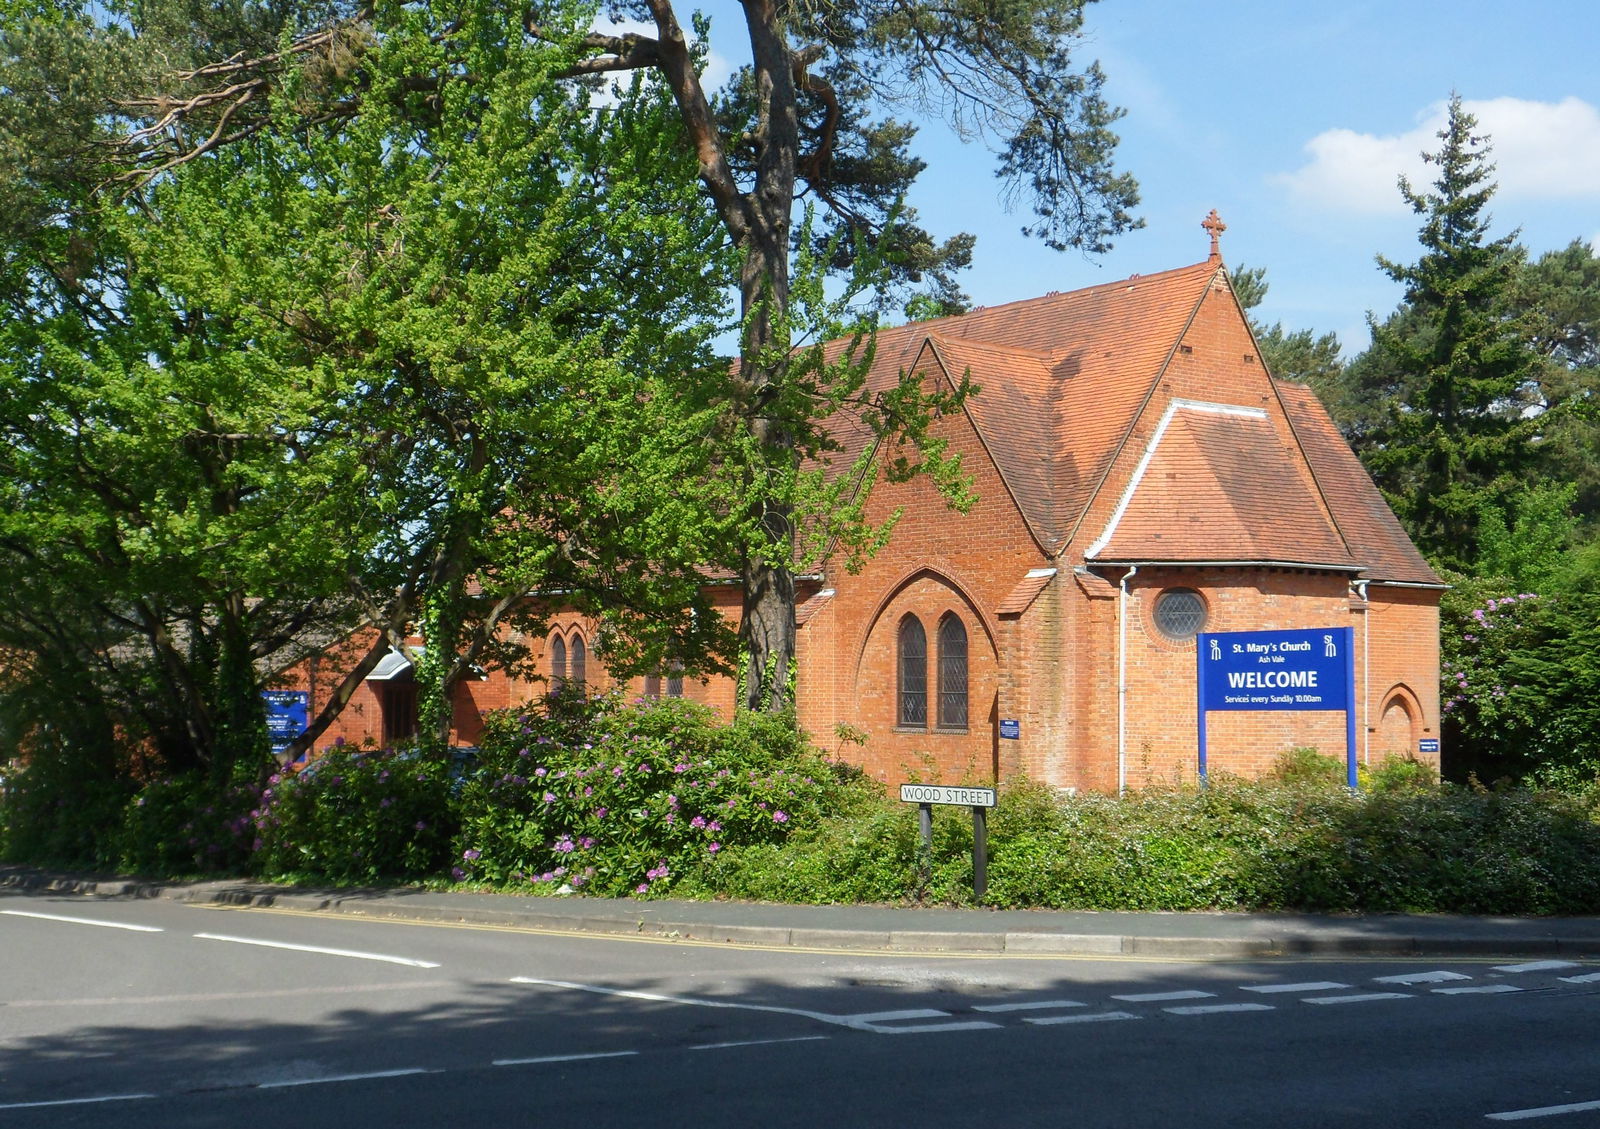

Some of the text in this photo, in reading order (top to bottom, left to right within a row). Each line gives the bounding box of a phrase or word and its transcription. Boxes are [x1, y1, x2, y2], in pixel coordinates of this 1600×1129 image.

[1232, 641, 1311, 654] St. Mary's Church
[1272, 655, 1285, 663] Vale
[1228, 671, 1318, 688] WELCOME
[1224, 695, 1249, 703] Services
[1251, 696, 1268, 704] every
[1270, 695, 1293, 704] Sunday
[904, 787, 991, 804] WOOD STREET
